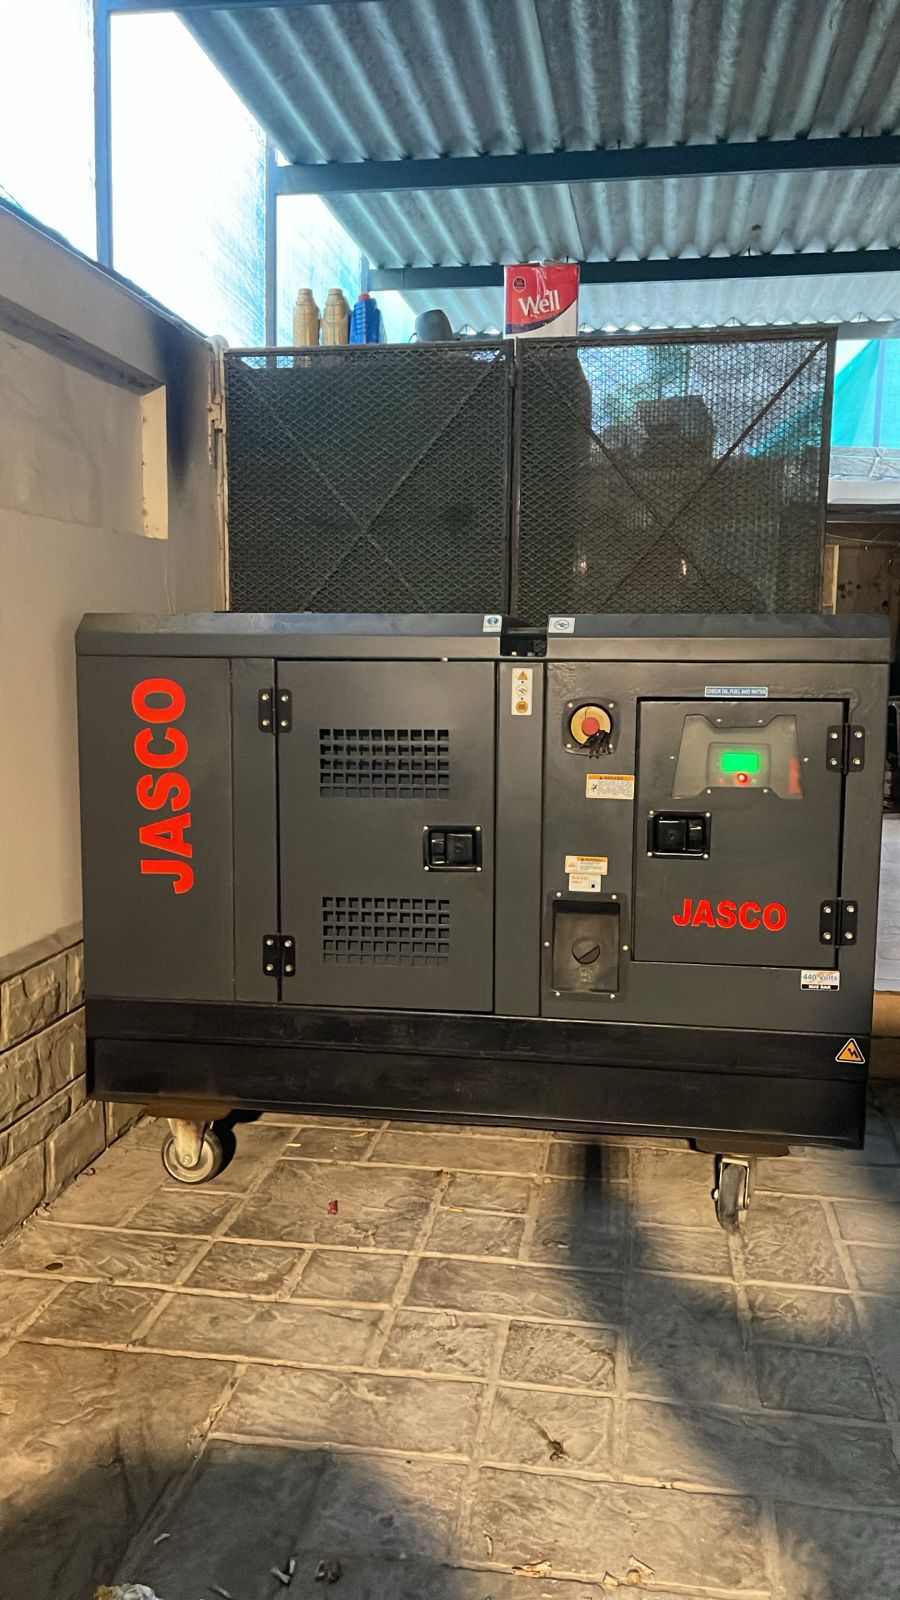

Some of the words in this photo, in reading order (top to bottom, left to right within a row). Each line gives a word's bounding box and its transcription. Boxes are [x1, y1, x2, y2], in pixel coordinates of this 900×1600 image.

[518, 289, 560, 316] Well
[131, 678, 195, 894] JASCO
[672, 898, 787, 931] JASCO
[803, 973, 817, 981] 440
[819, 973, 838, 981] Volts
